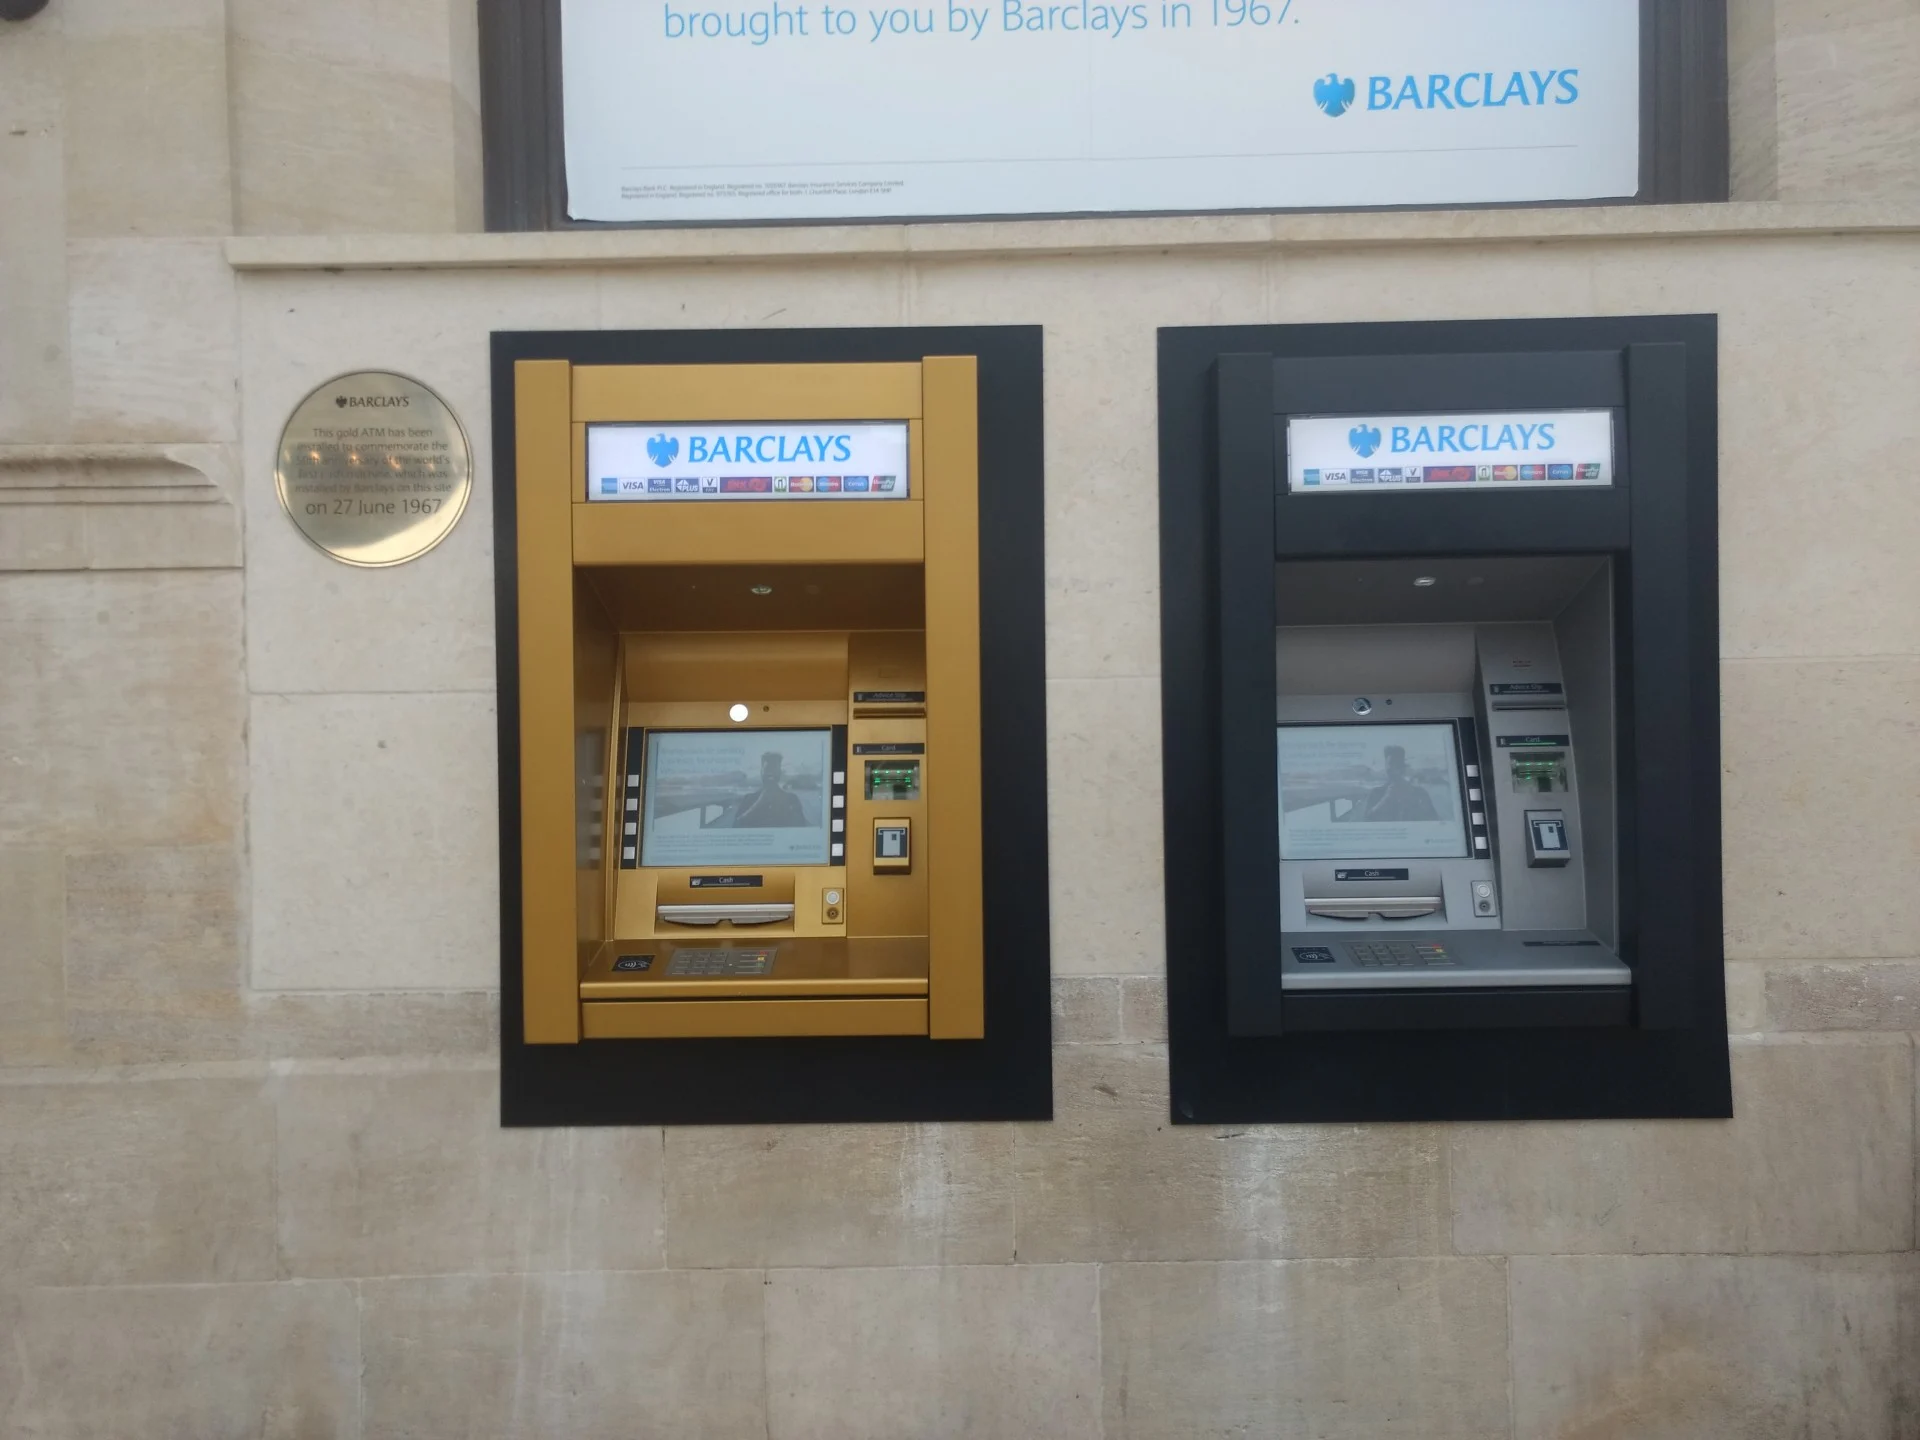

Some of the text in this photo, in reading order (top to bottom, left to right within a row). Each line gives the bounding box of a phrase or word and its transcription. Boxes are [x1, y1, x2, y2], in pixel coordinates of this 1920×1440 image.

[664, 2, 809, 46] brought
[822, 5, 857, 35] to
[869, 8, 934, 42] you
[948, 0, 989, 41] by
[1002, 0, 1148, 38] Barclays
[1161, 0, 1191, 28] in
[1366, 69, 1579, 111] BARCLAYS
[348, 396, 410, 409] BARCLAYS
[313, 427, 433, 441] This gold ATM has been
[1390, 424, 1556, 454] BARCLAYS
[431, 440, 449, 451] the
[687, 434, 852, 463] BARCLAYS
[1325, 472, 1347, 481] VISA
[413, 483, 432, 492] this
[434, 483, 452, 492] site
[622, 481, 644, 490] VISA
[683, 484, 699, 492] PLUS
[306, 498, 443, 516] on 27 June 1967
[1364, 869, 1380, 877] Cash
[718, 876, 734, 884] Cash
